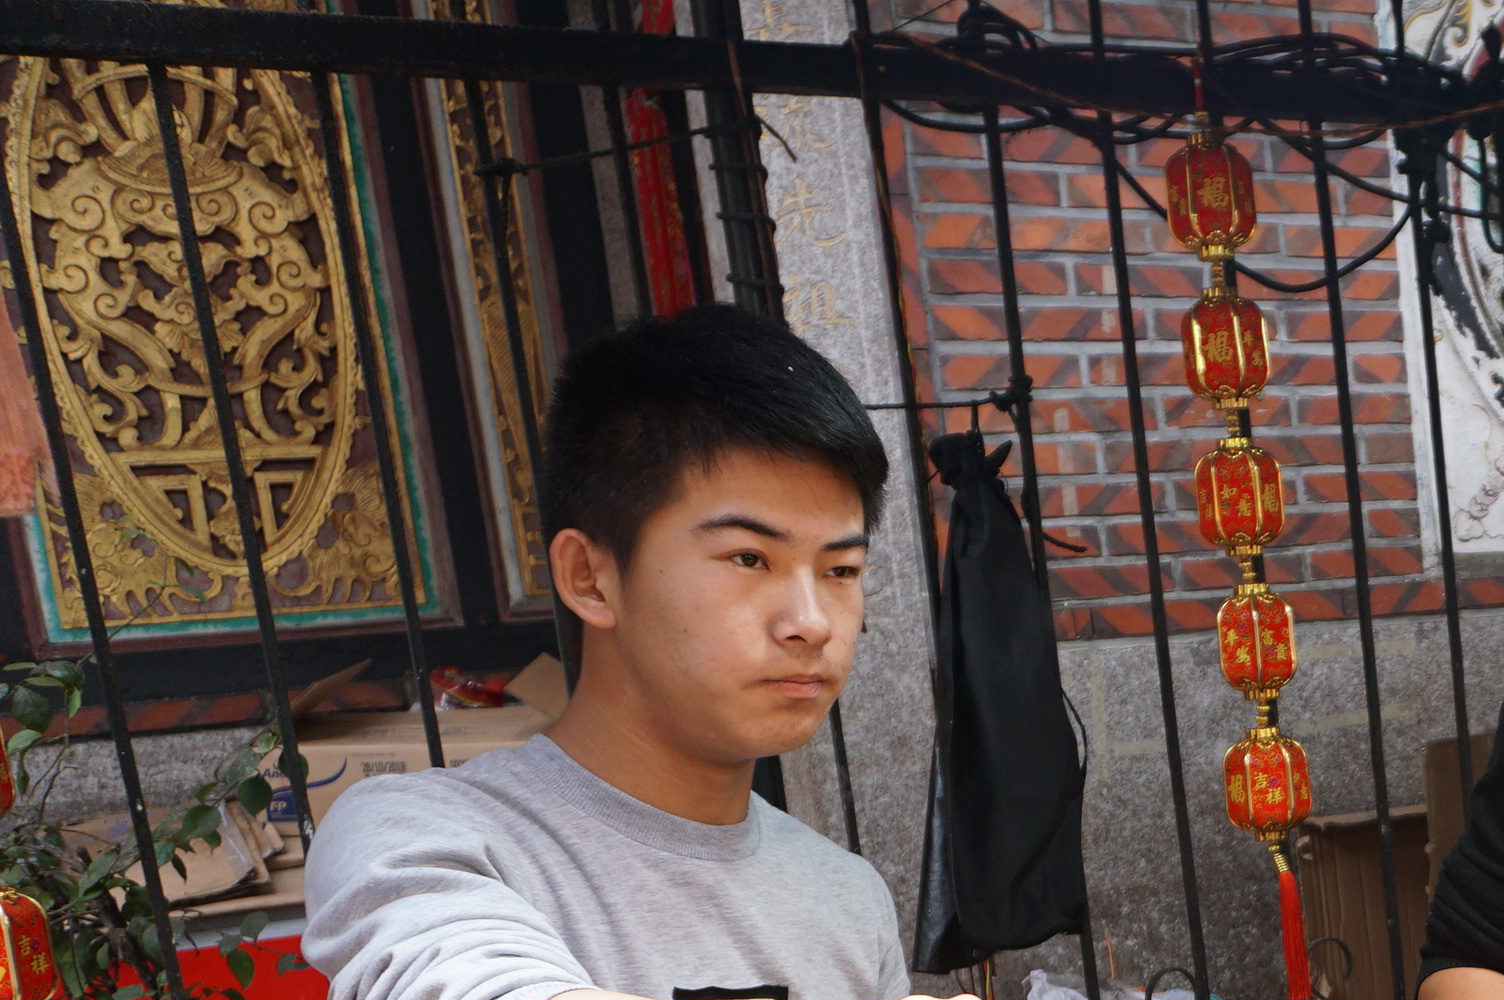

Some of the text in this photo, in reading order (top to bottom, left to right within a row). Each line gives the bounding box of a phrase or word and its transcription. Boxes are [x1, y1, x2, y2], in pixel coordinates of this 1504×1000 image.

[1196, 176, 1229, 208] 福
[1202, 330, 1233, 362] 福
[1219, 484, 1252, 517] 如意
[1261, 483, 1279, 512] 福
[1224, 628, 1251, 664] 平安
[1228, 774, 1246, 803] 福
[1253, 771, 1283, 804] 吉祥
[18, 934, 49, 975] 吉祥
